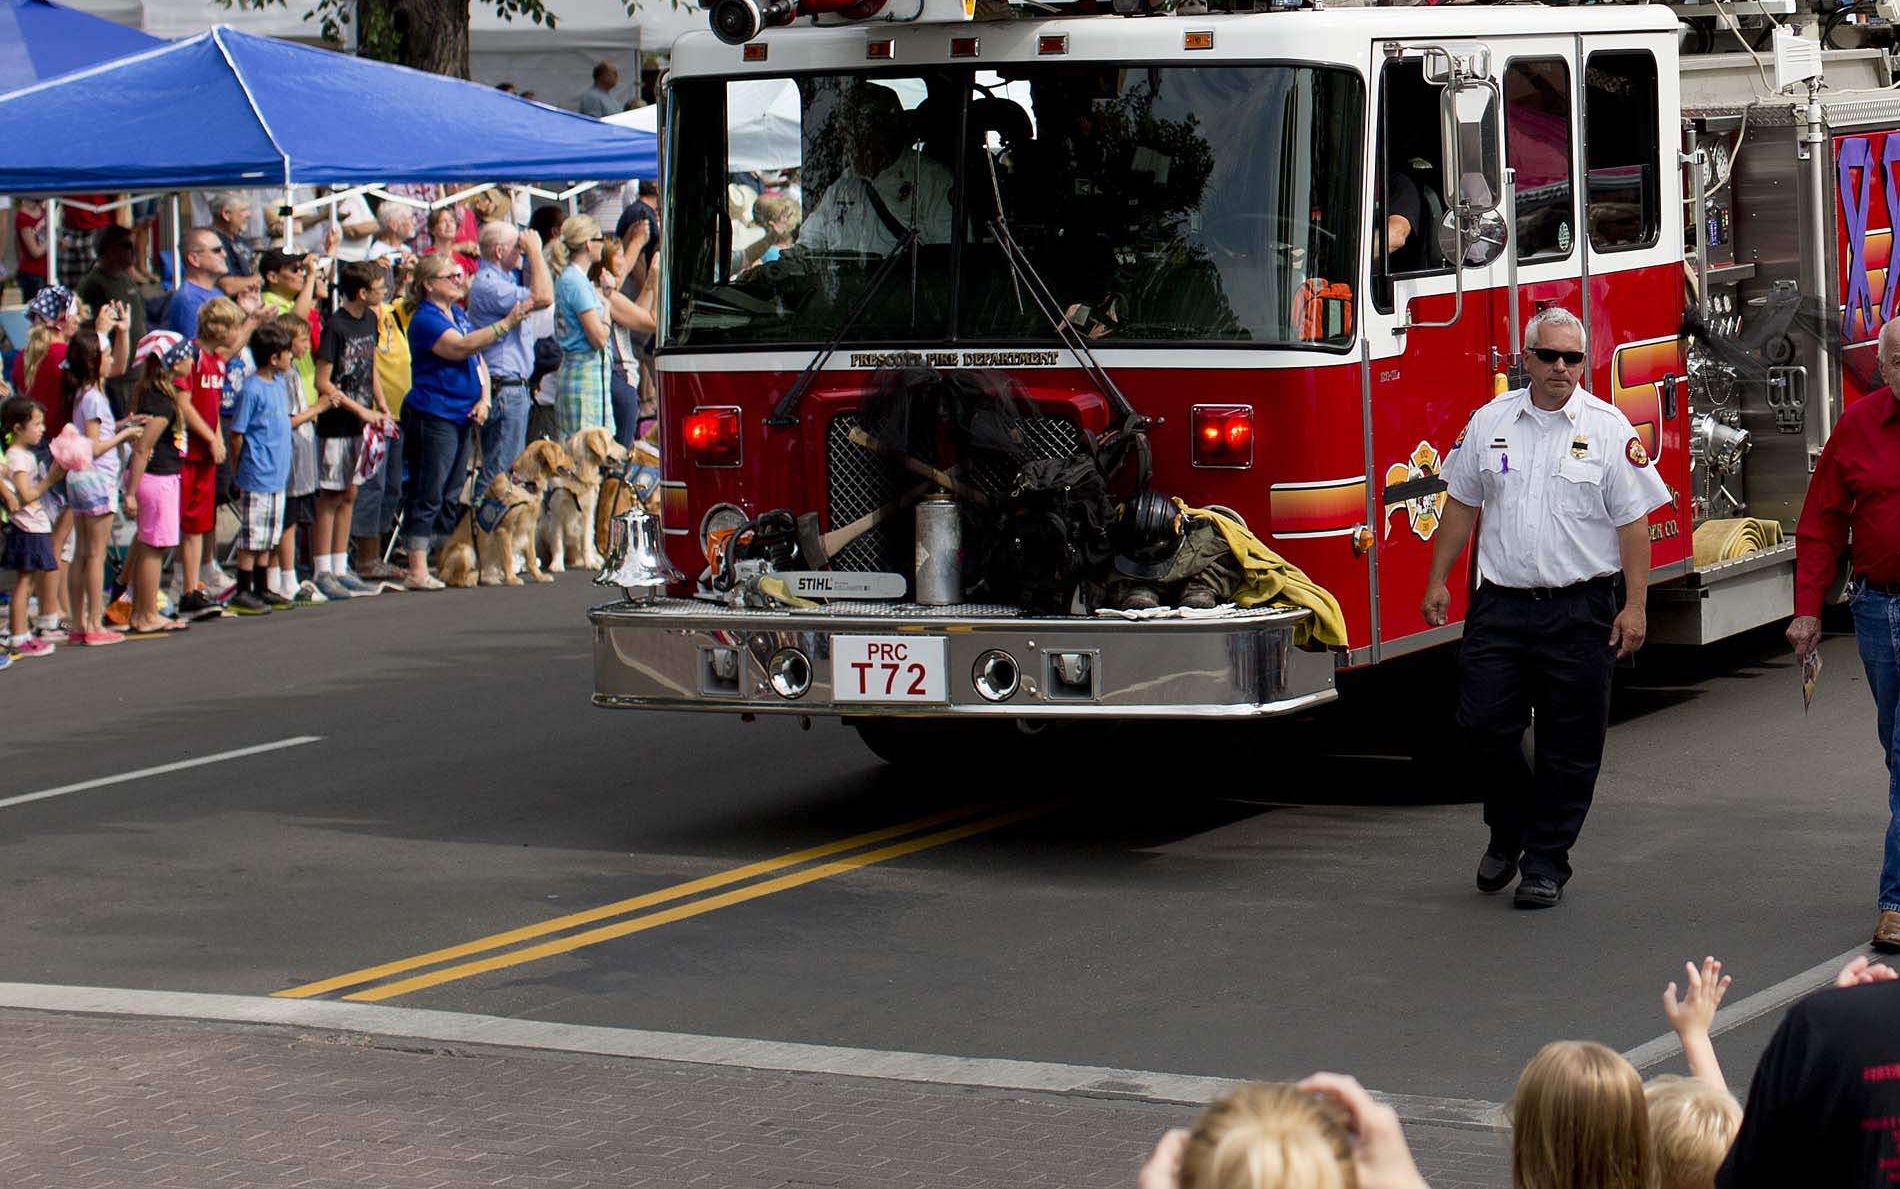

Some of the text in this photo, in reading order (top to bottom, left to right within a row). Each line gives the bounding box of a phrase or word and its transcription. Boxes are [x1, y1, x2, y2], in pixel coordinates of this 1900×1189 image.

[926, 352, 960, 367] FIRE
[962, 350, 1060, 366] DEPARTMENT
[1664, 518, 1680, 540] CO.
[798, 577, 833, 591] STIHL
[867, 643, 908, 661] PRC
[851, 663, 927, 696] T72
